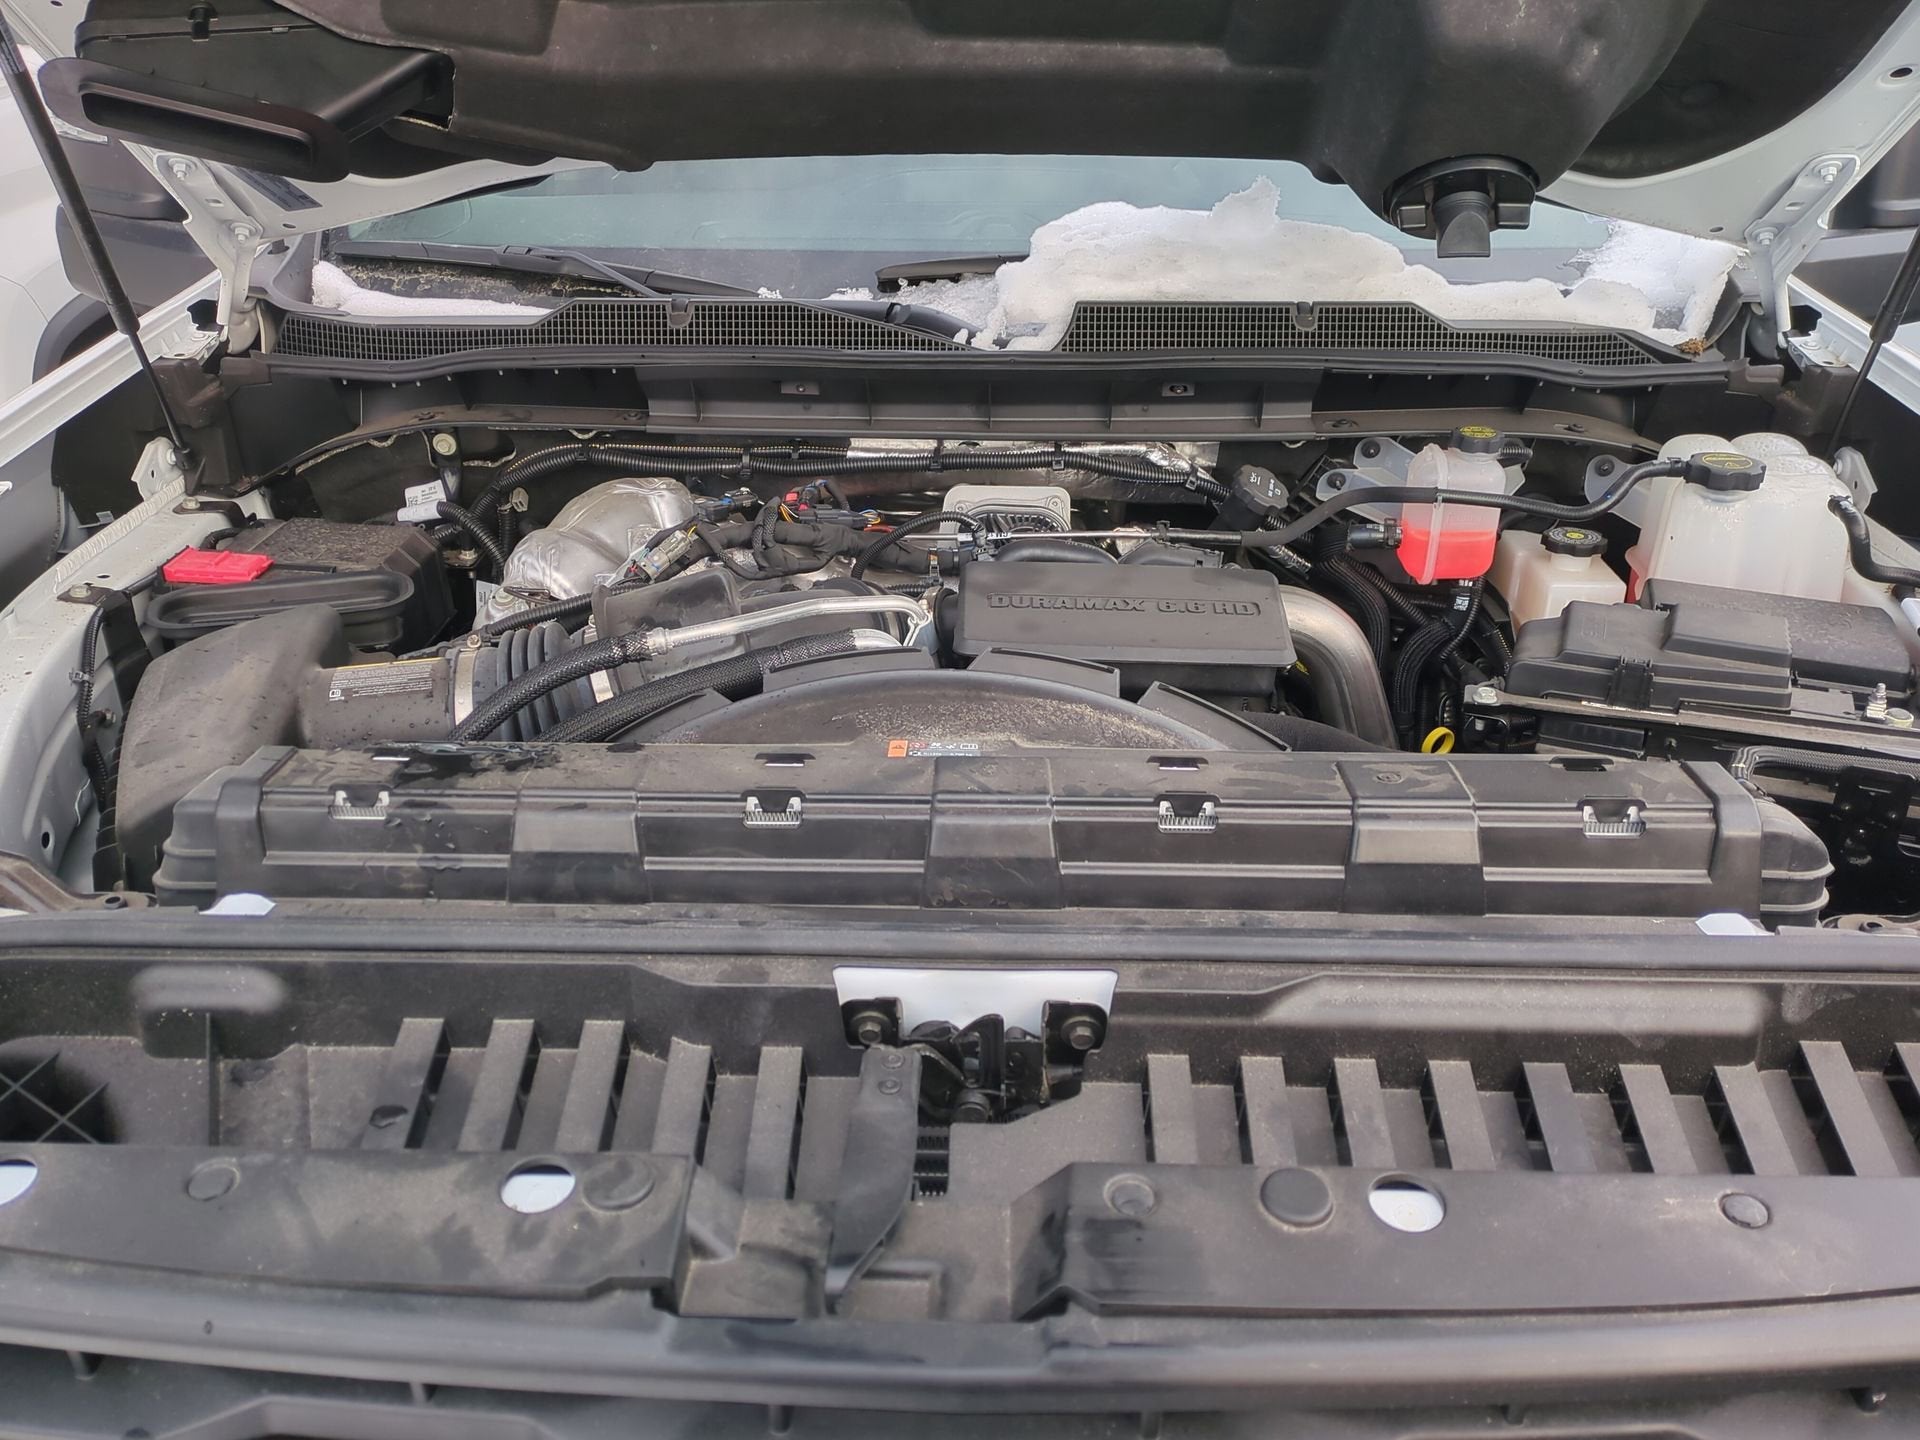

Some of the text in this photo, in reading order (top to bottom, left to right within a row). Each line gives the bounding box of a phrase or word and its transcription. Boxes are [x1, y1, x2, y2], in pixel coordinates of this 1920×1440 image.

[988, 594, 1255, 616] DURAMAX 6.6 HD
